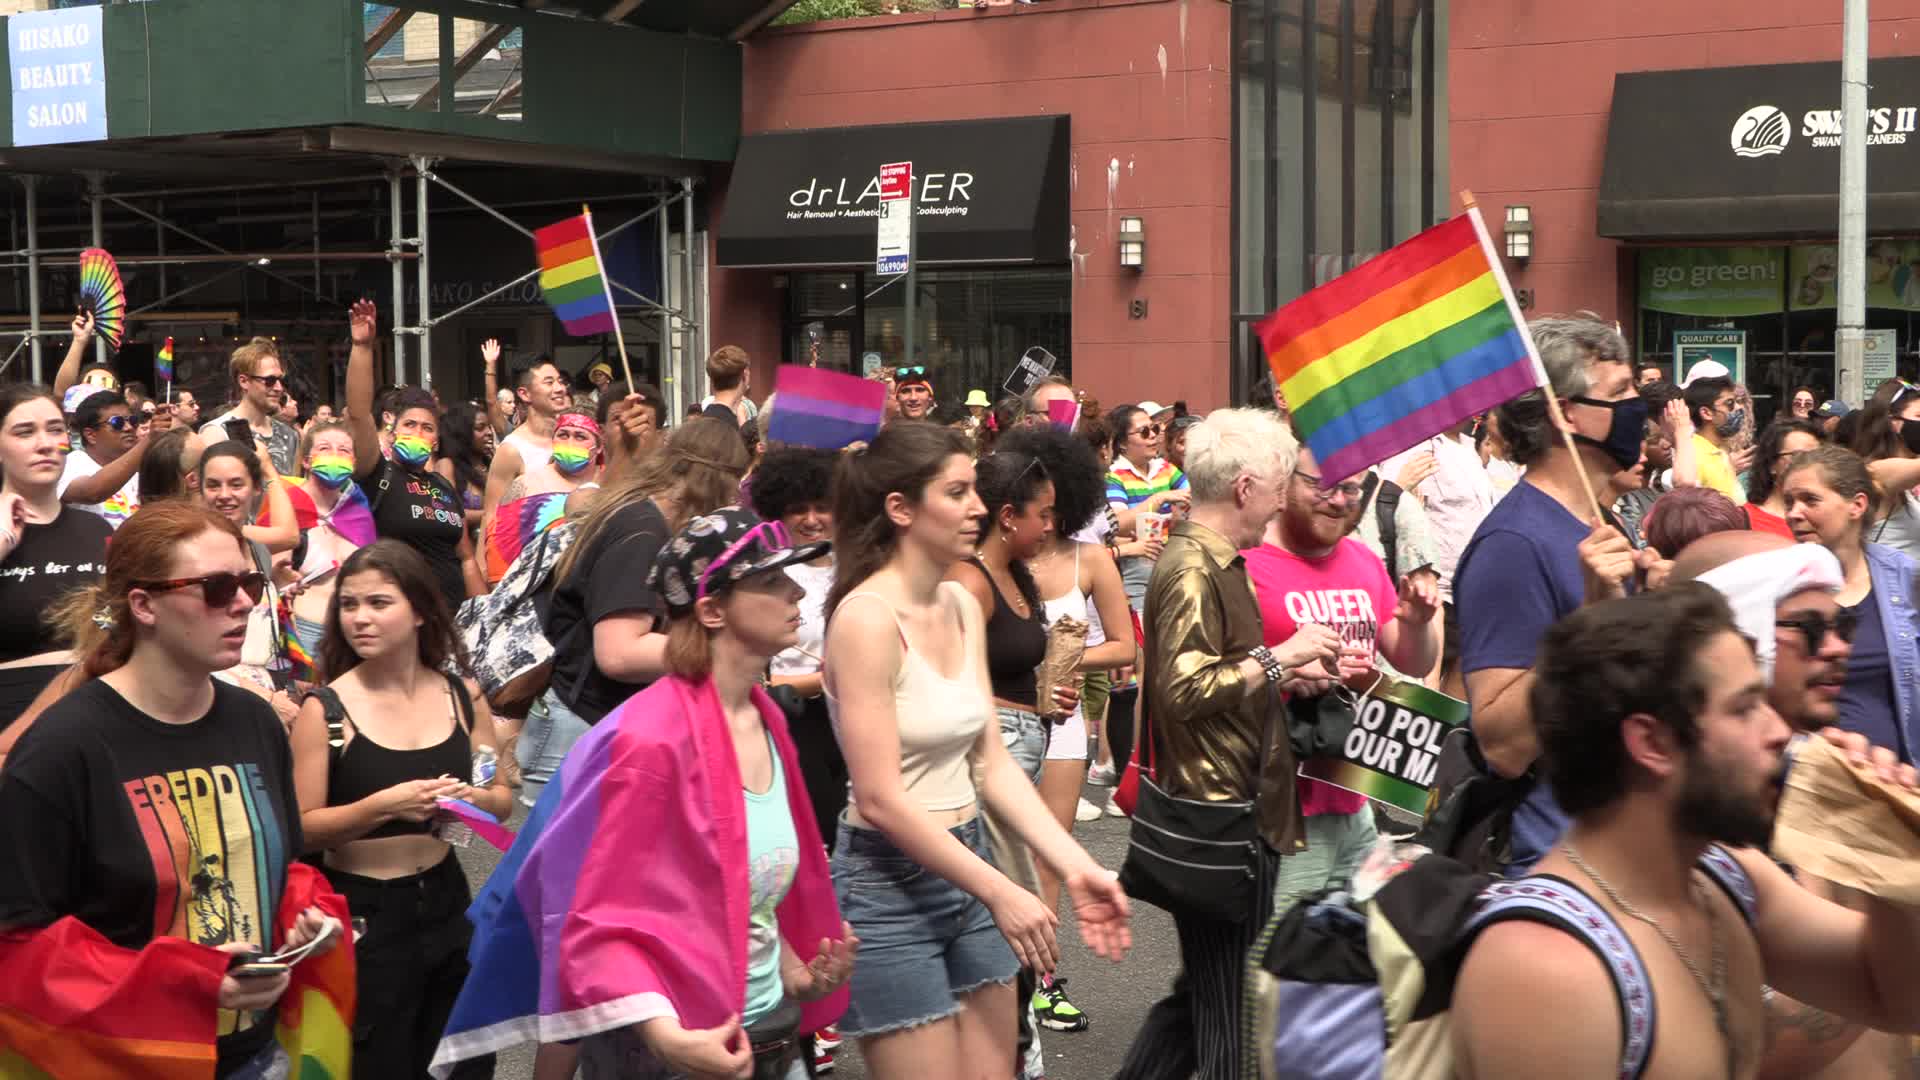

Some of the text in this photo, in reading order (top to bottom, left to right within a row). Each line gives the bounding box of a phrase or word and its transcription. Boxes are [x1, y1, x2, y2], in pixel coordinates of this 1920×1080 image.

[19, 23, 88, 50] HISAKO
[20, 62, 93, 89] BEAUTY
[28, 101, 87, 127] SALON
[1895, 107, 1918, 132] II
[1812, 133, 1907, 147] SWAN EANERS
[889, 167, 906, 176] STOPPING
[789, 173, 973, 206] drLAER
[787, 211, 803, 219] Hair
[804, 205, 837, 219] Removal
[844, 204, 880, 217] Aesthetic
[882, 203, 888, 218] 2
[878, 262, 900, 272] 106990
[1653, 261, 1776, 288] go green!
[1681, 335, 1738, 344] QUALITY CARE
[1284, 588, 1377, 624] QUEER
[1387, 707, 1443, 756] POL
[1344, 728, 1440, 787] OUR MA
[122, 762, 266, 812] FREDDIE
